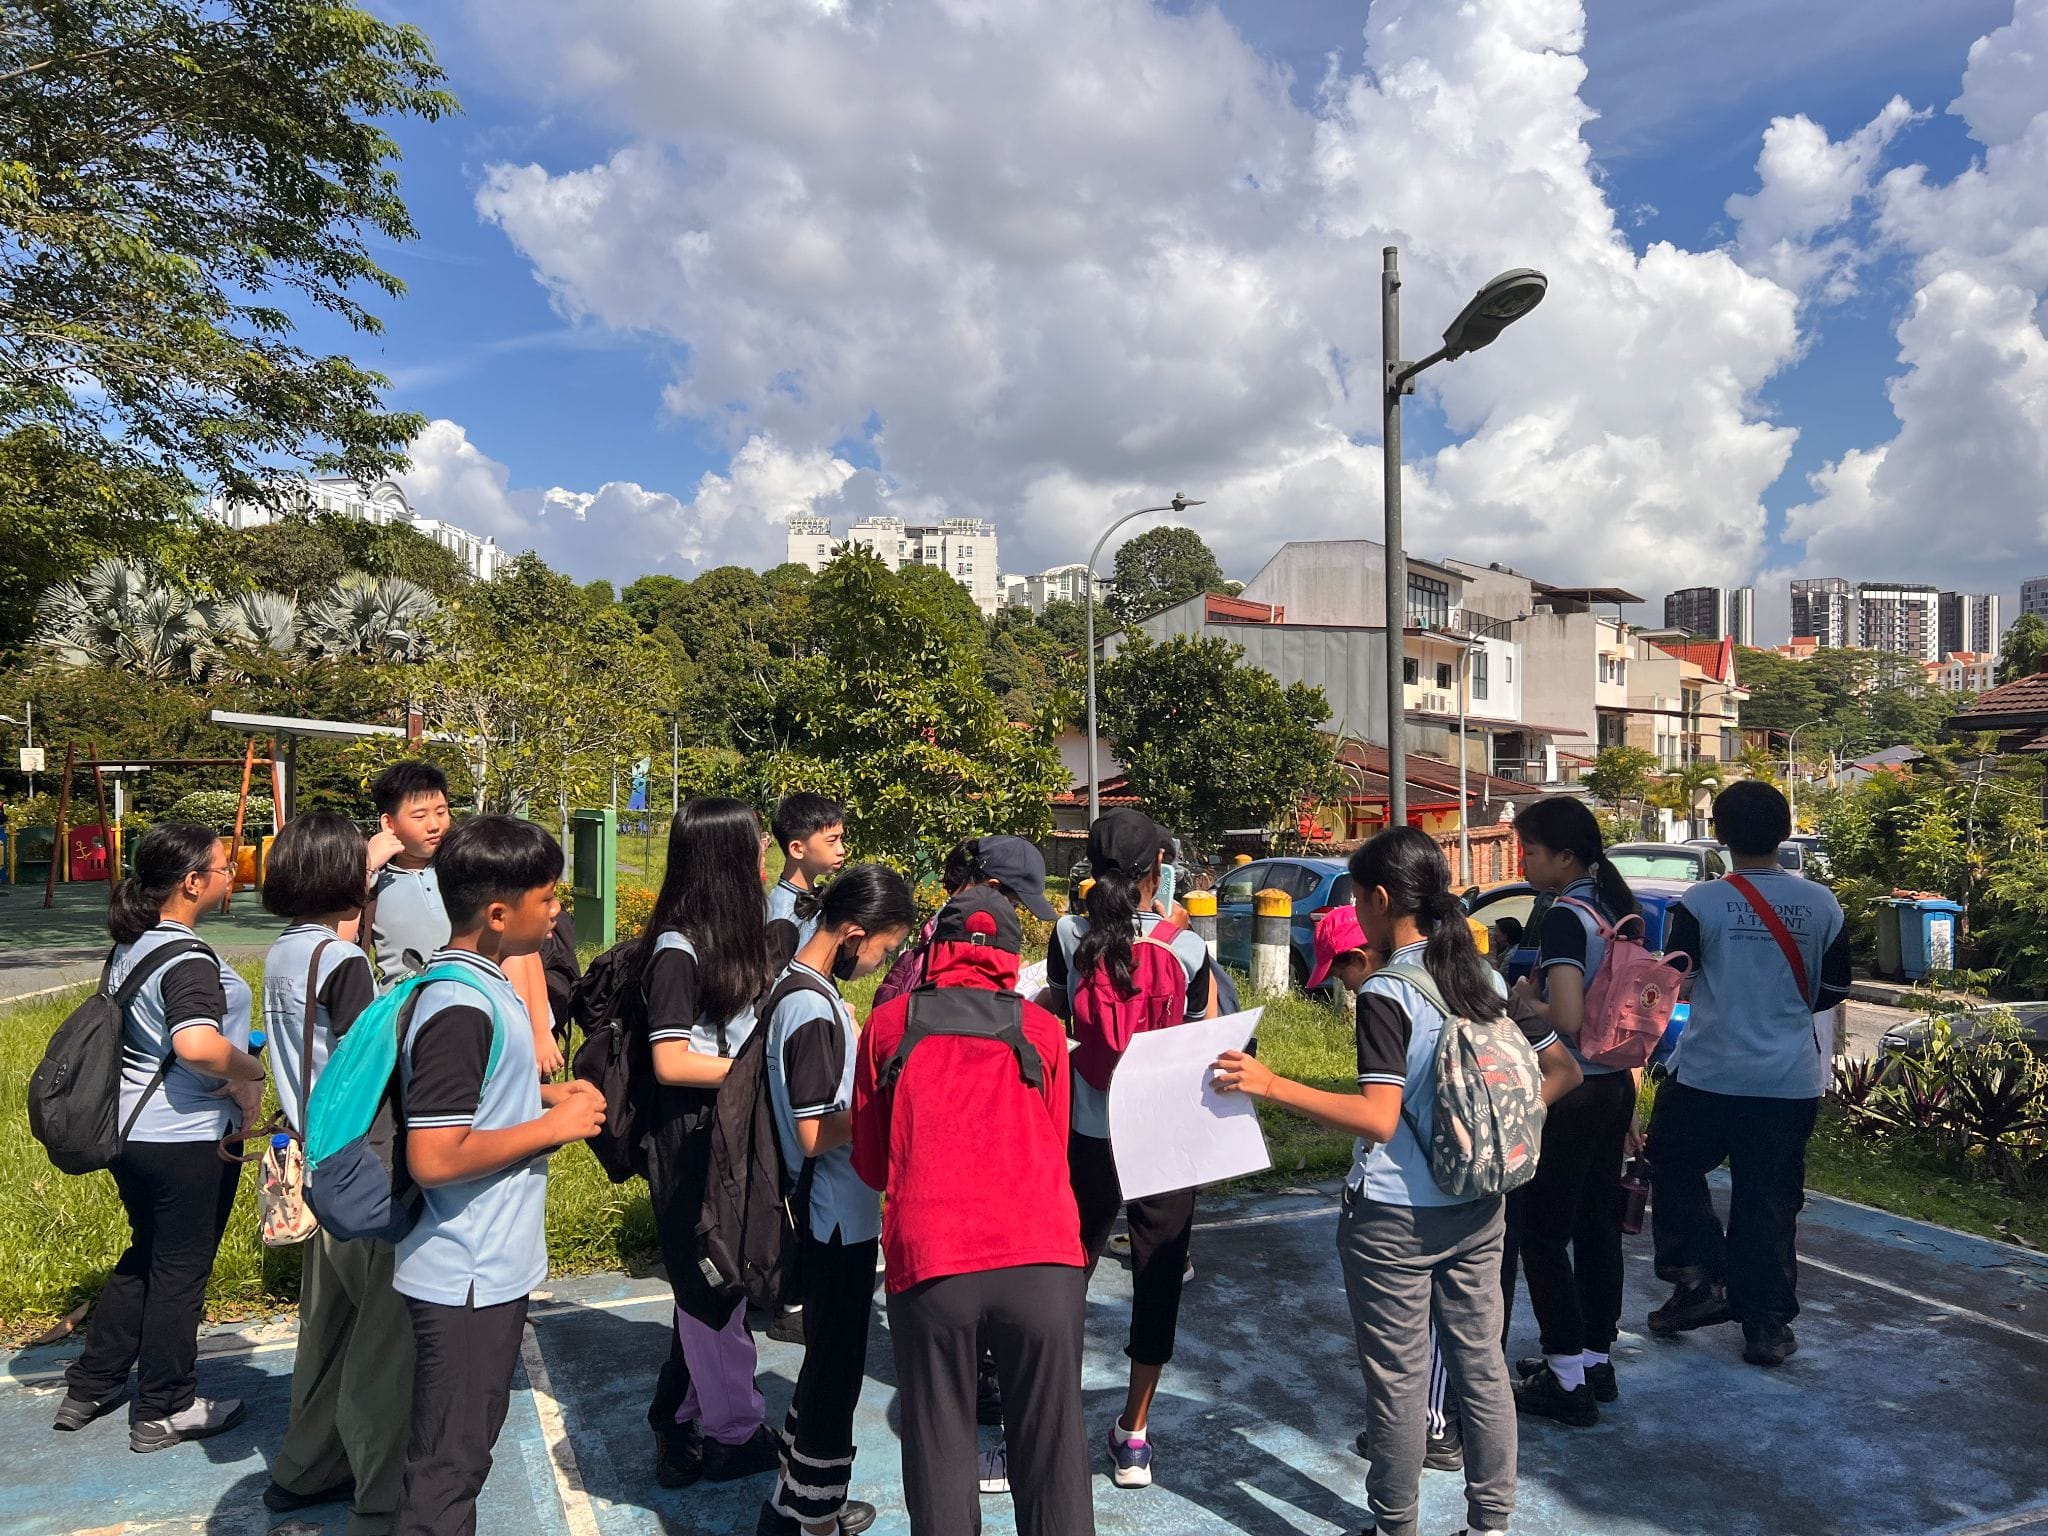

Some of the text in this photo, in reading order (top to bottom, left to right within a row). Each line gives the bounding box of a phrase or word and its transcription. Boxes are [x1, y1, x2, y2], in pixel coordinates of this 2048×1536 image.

[1727, 901, 1812, 917] EVEONE'S
[1737, 914, 1805, 929] A TNT
